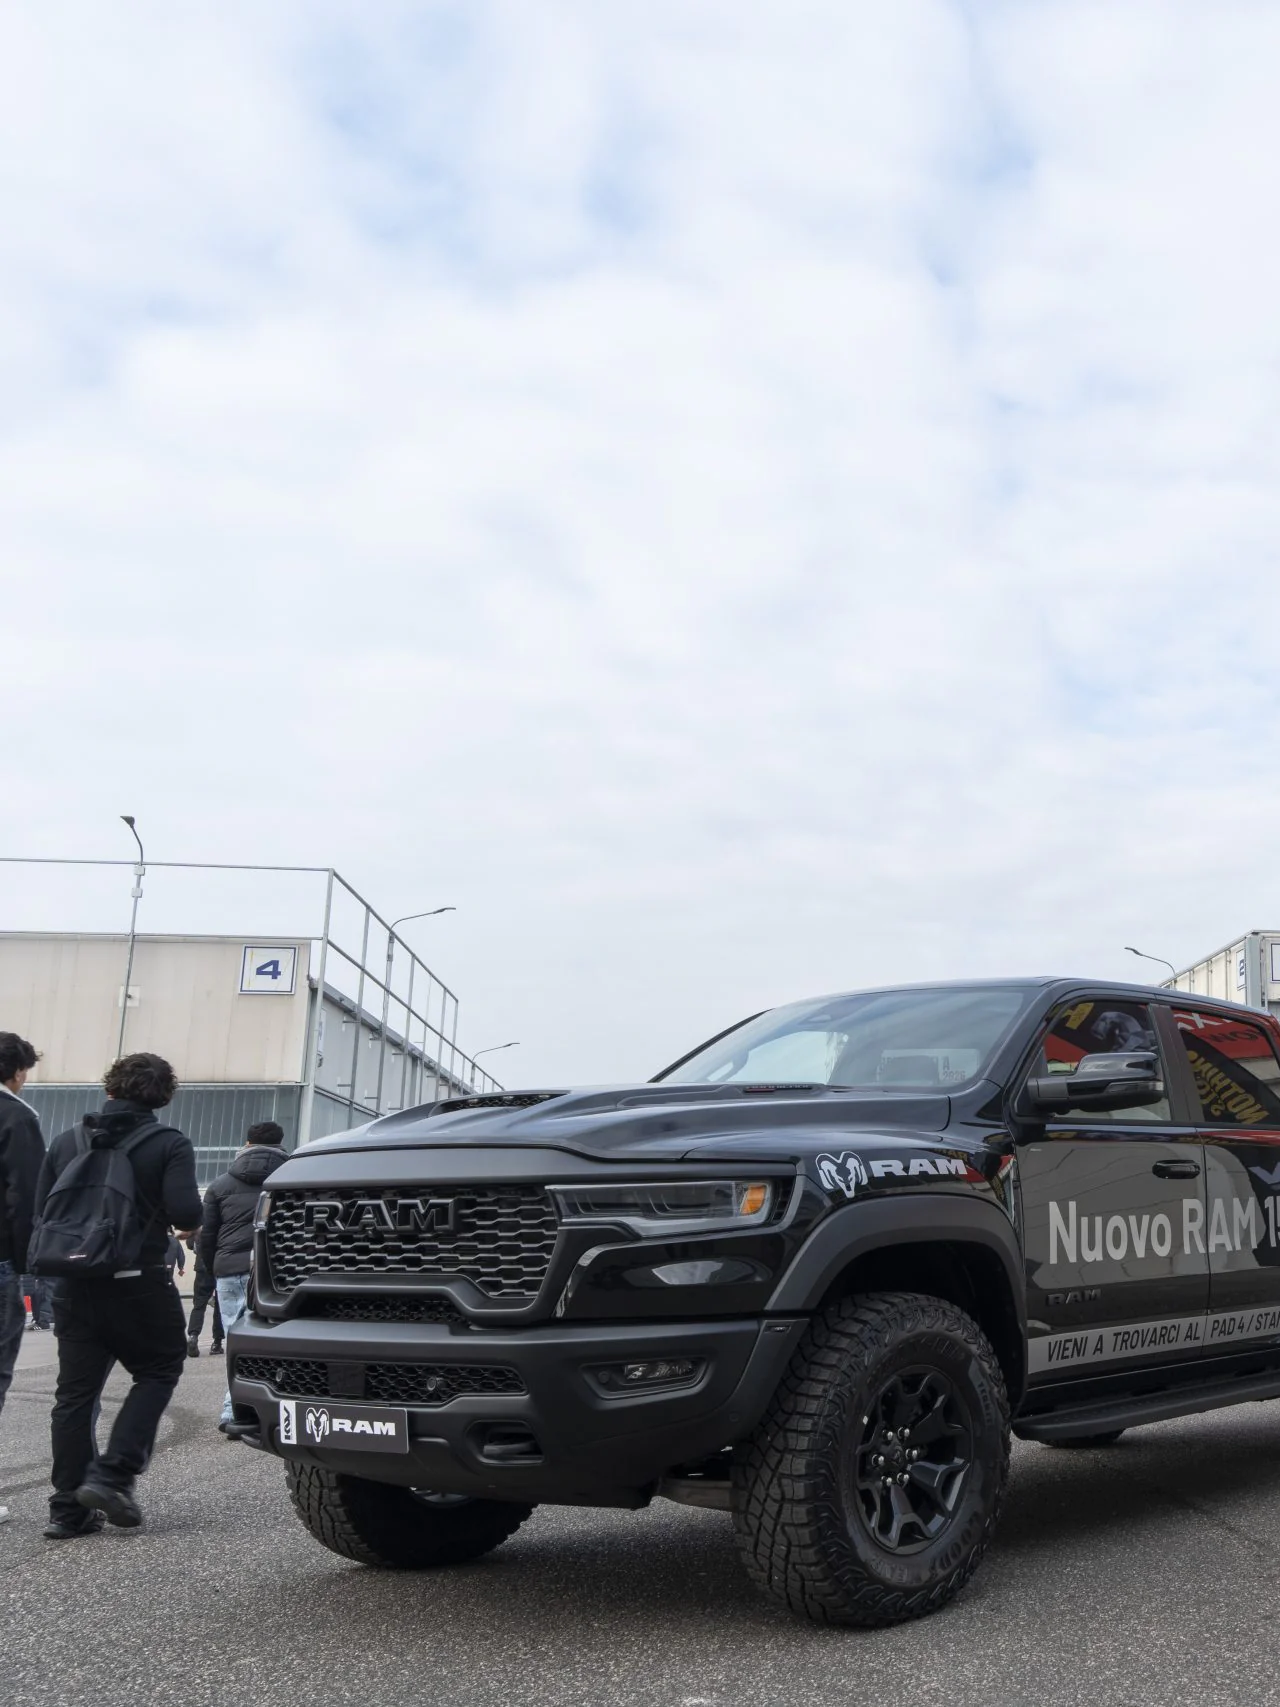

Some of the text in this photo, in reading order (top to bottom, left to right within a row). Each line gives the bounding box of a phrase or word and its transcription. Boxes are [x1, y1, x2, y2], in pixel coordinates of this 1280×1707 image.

[255, 959, 282, 980] 4
[869, 1158, 968, 1177] RAM
[304, 1199, 454, 1231] RAM
[1048, 1200, 1172, 1265] Nuovo
[1182, 1195, 1258, 1255] RAM
[1046, 1288, 1102, 1307] RAM
[1047, 1336, 1088, 1362] VIENI
[1093, 1335, 1105, 1356] A
[1112, 1324, 1180, 1352] TROVARCI
[1183, 1321, 1201, 1342] AL
[1210, 1318, 1234, 1338] PAD
[331, 1418, 396, 1436] RAM
